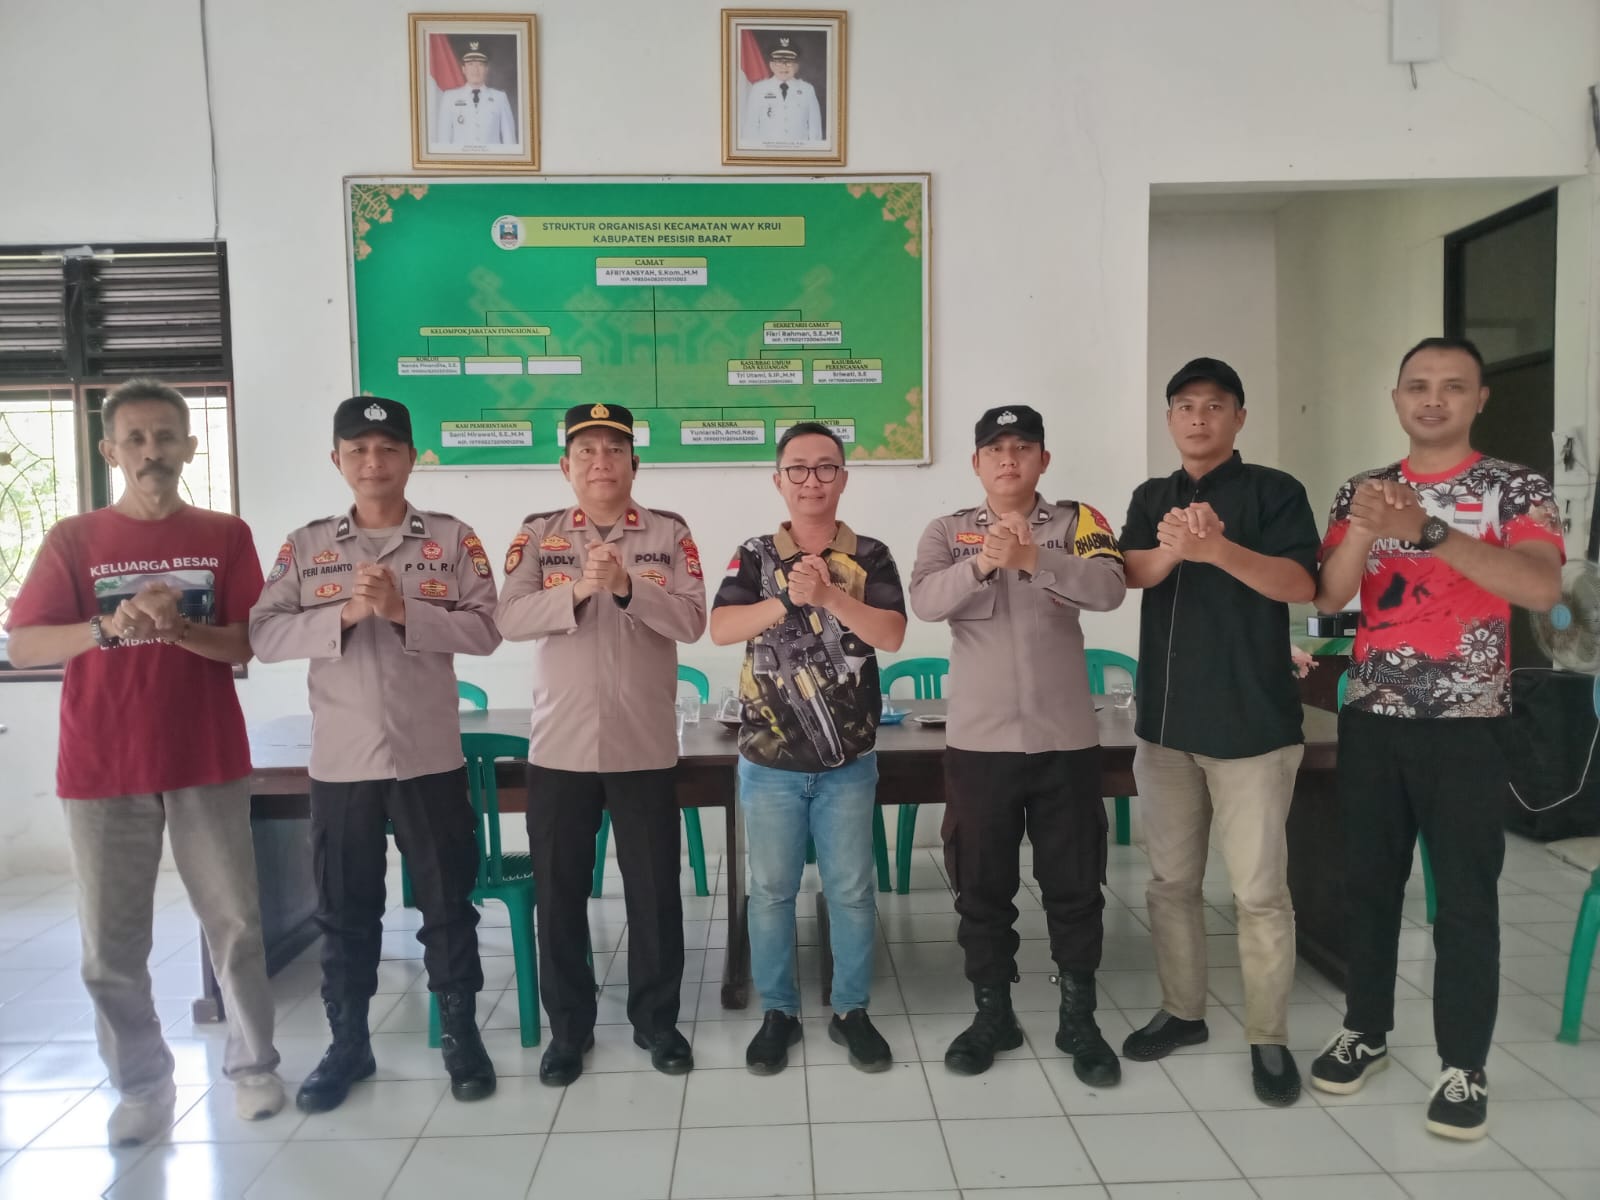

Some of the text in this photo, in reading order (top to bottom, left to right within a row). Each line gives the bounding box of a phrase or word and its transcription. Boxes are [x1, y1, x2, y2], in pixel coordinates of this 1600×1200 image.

[542, 222, 781, 231] STRUKTUR ORGANISASI KECAMATAN WAY KRUI
[593, 234, 732, 243] KABUPATEN PESISIR BARAT
[538, 555, 575, 567] HADLY
[635, 553, 671, 565] POLRI
[90, 557, 219, 576] KELUARGA BESAR
[302, 563, 353, 578] FERI ARIANTO
[404, 563, 455, 573] POLRI
